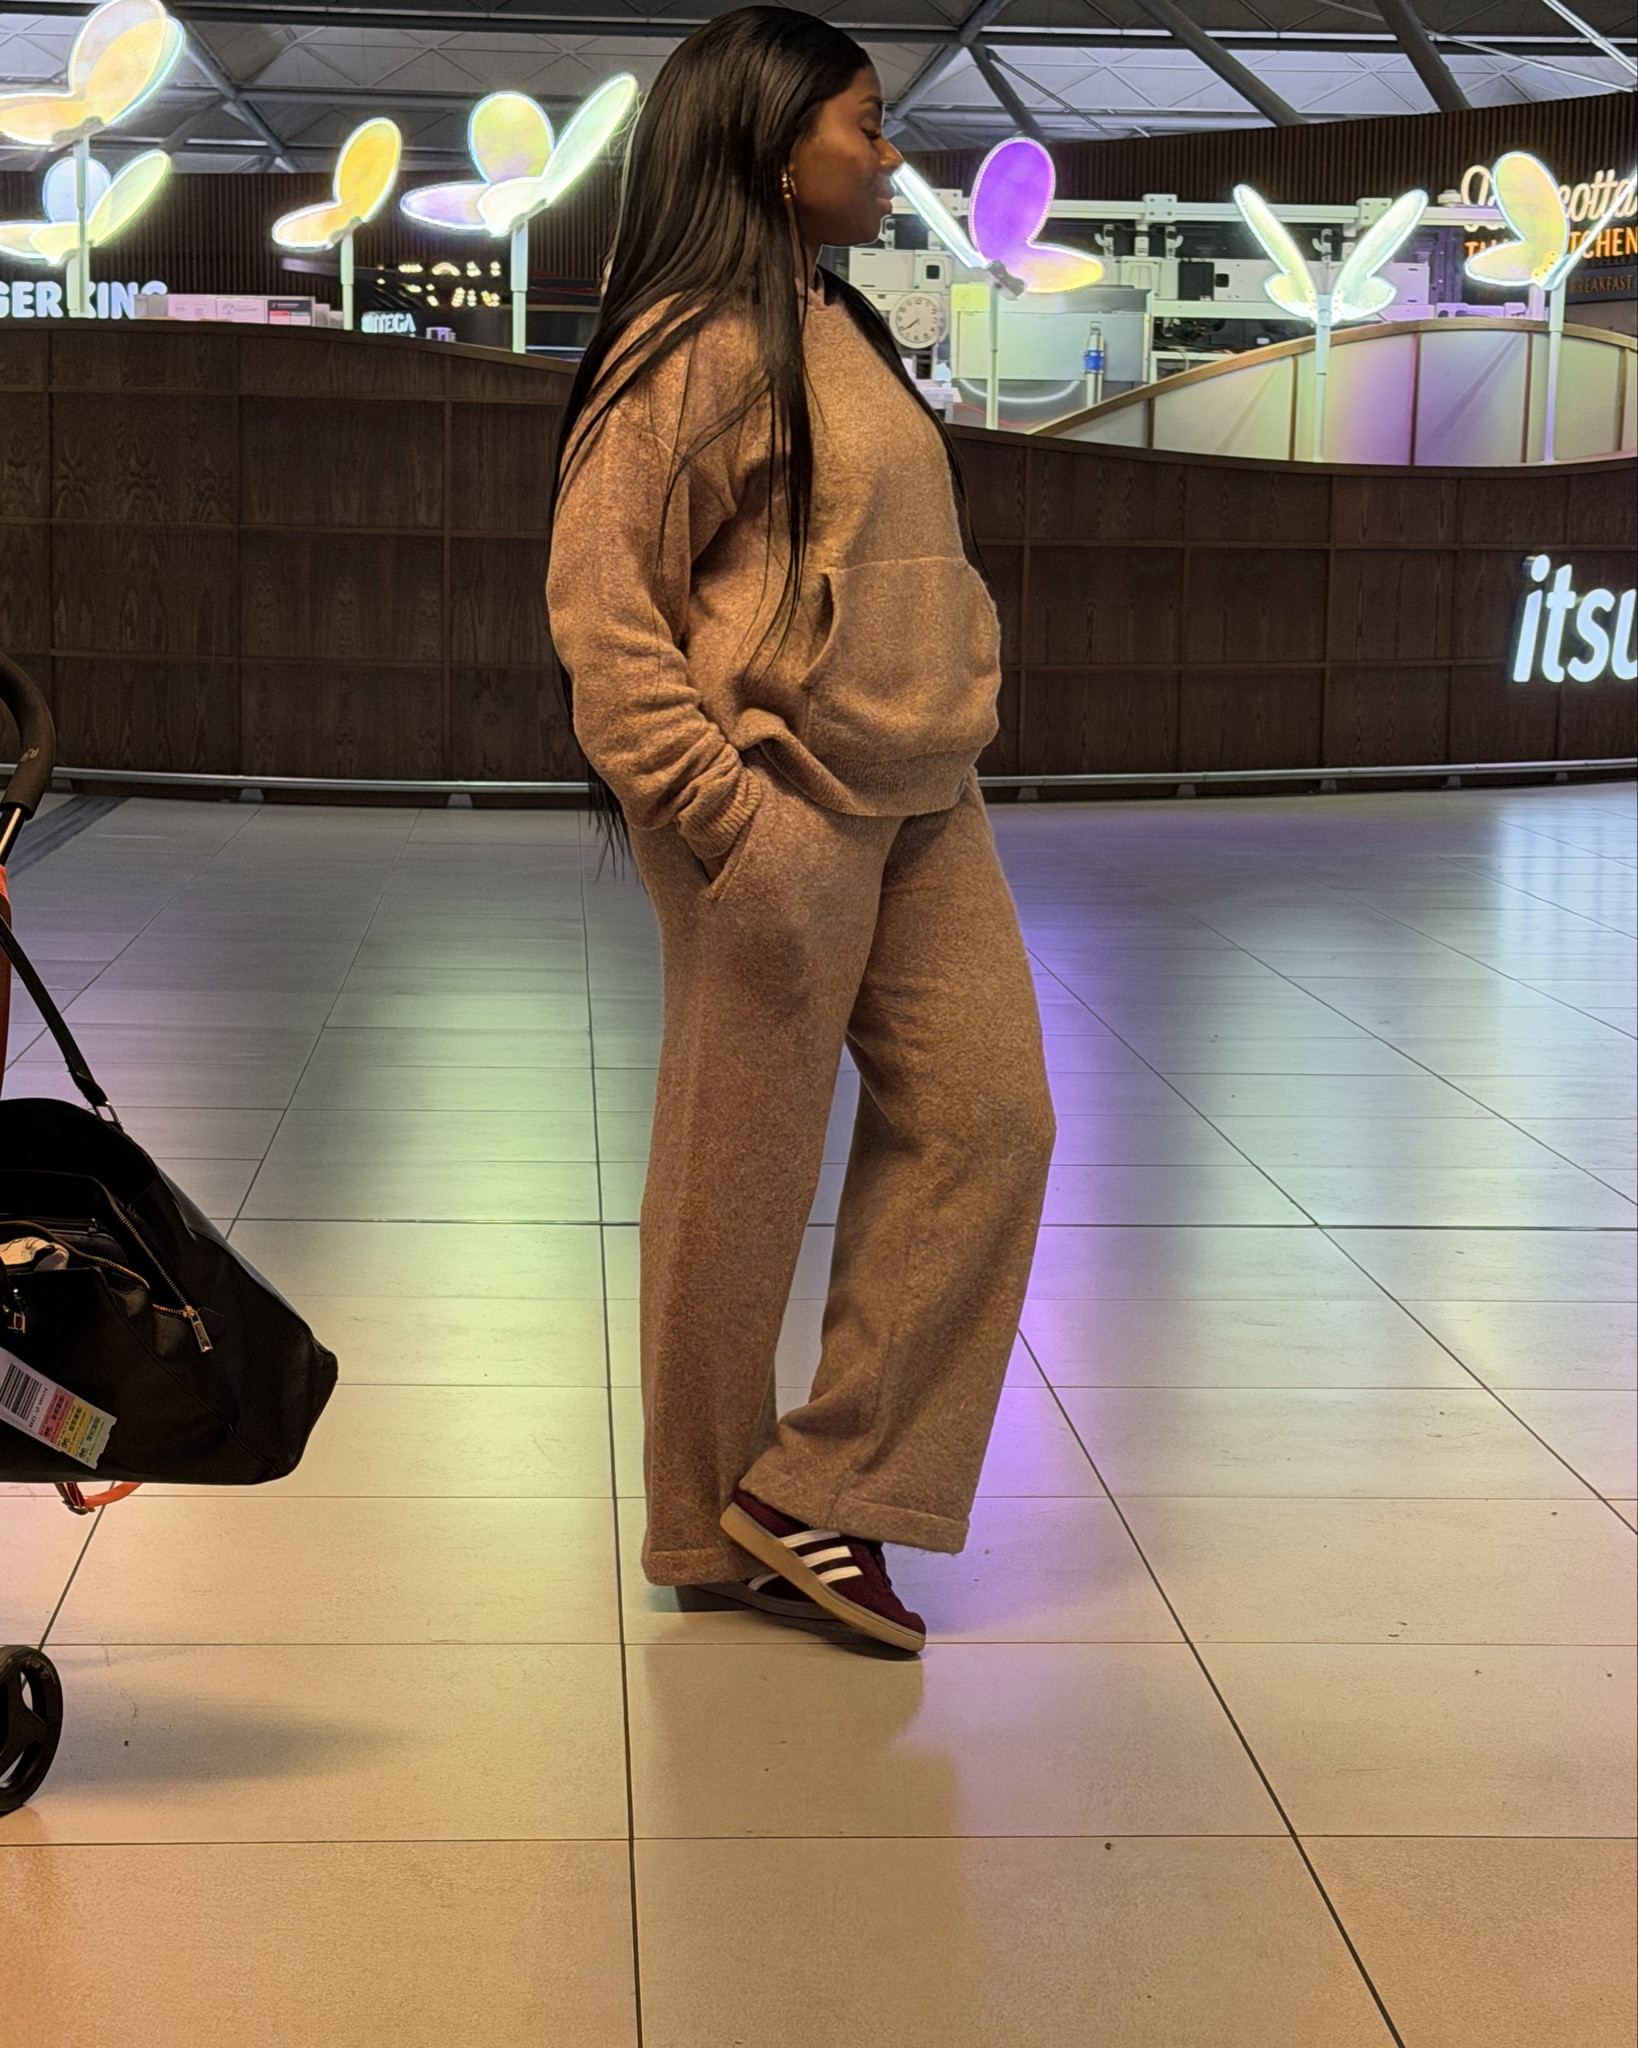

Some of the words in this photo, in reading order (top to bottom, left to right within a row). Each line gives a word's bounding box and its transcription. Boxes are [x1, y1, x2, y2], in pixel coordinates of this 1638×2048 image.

[1569, 226, 1638, 260] TCHEN
[1568, 274, 1633, 294] EAKFAST
[1513, 554, 1638, 682] itsu
